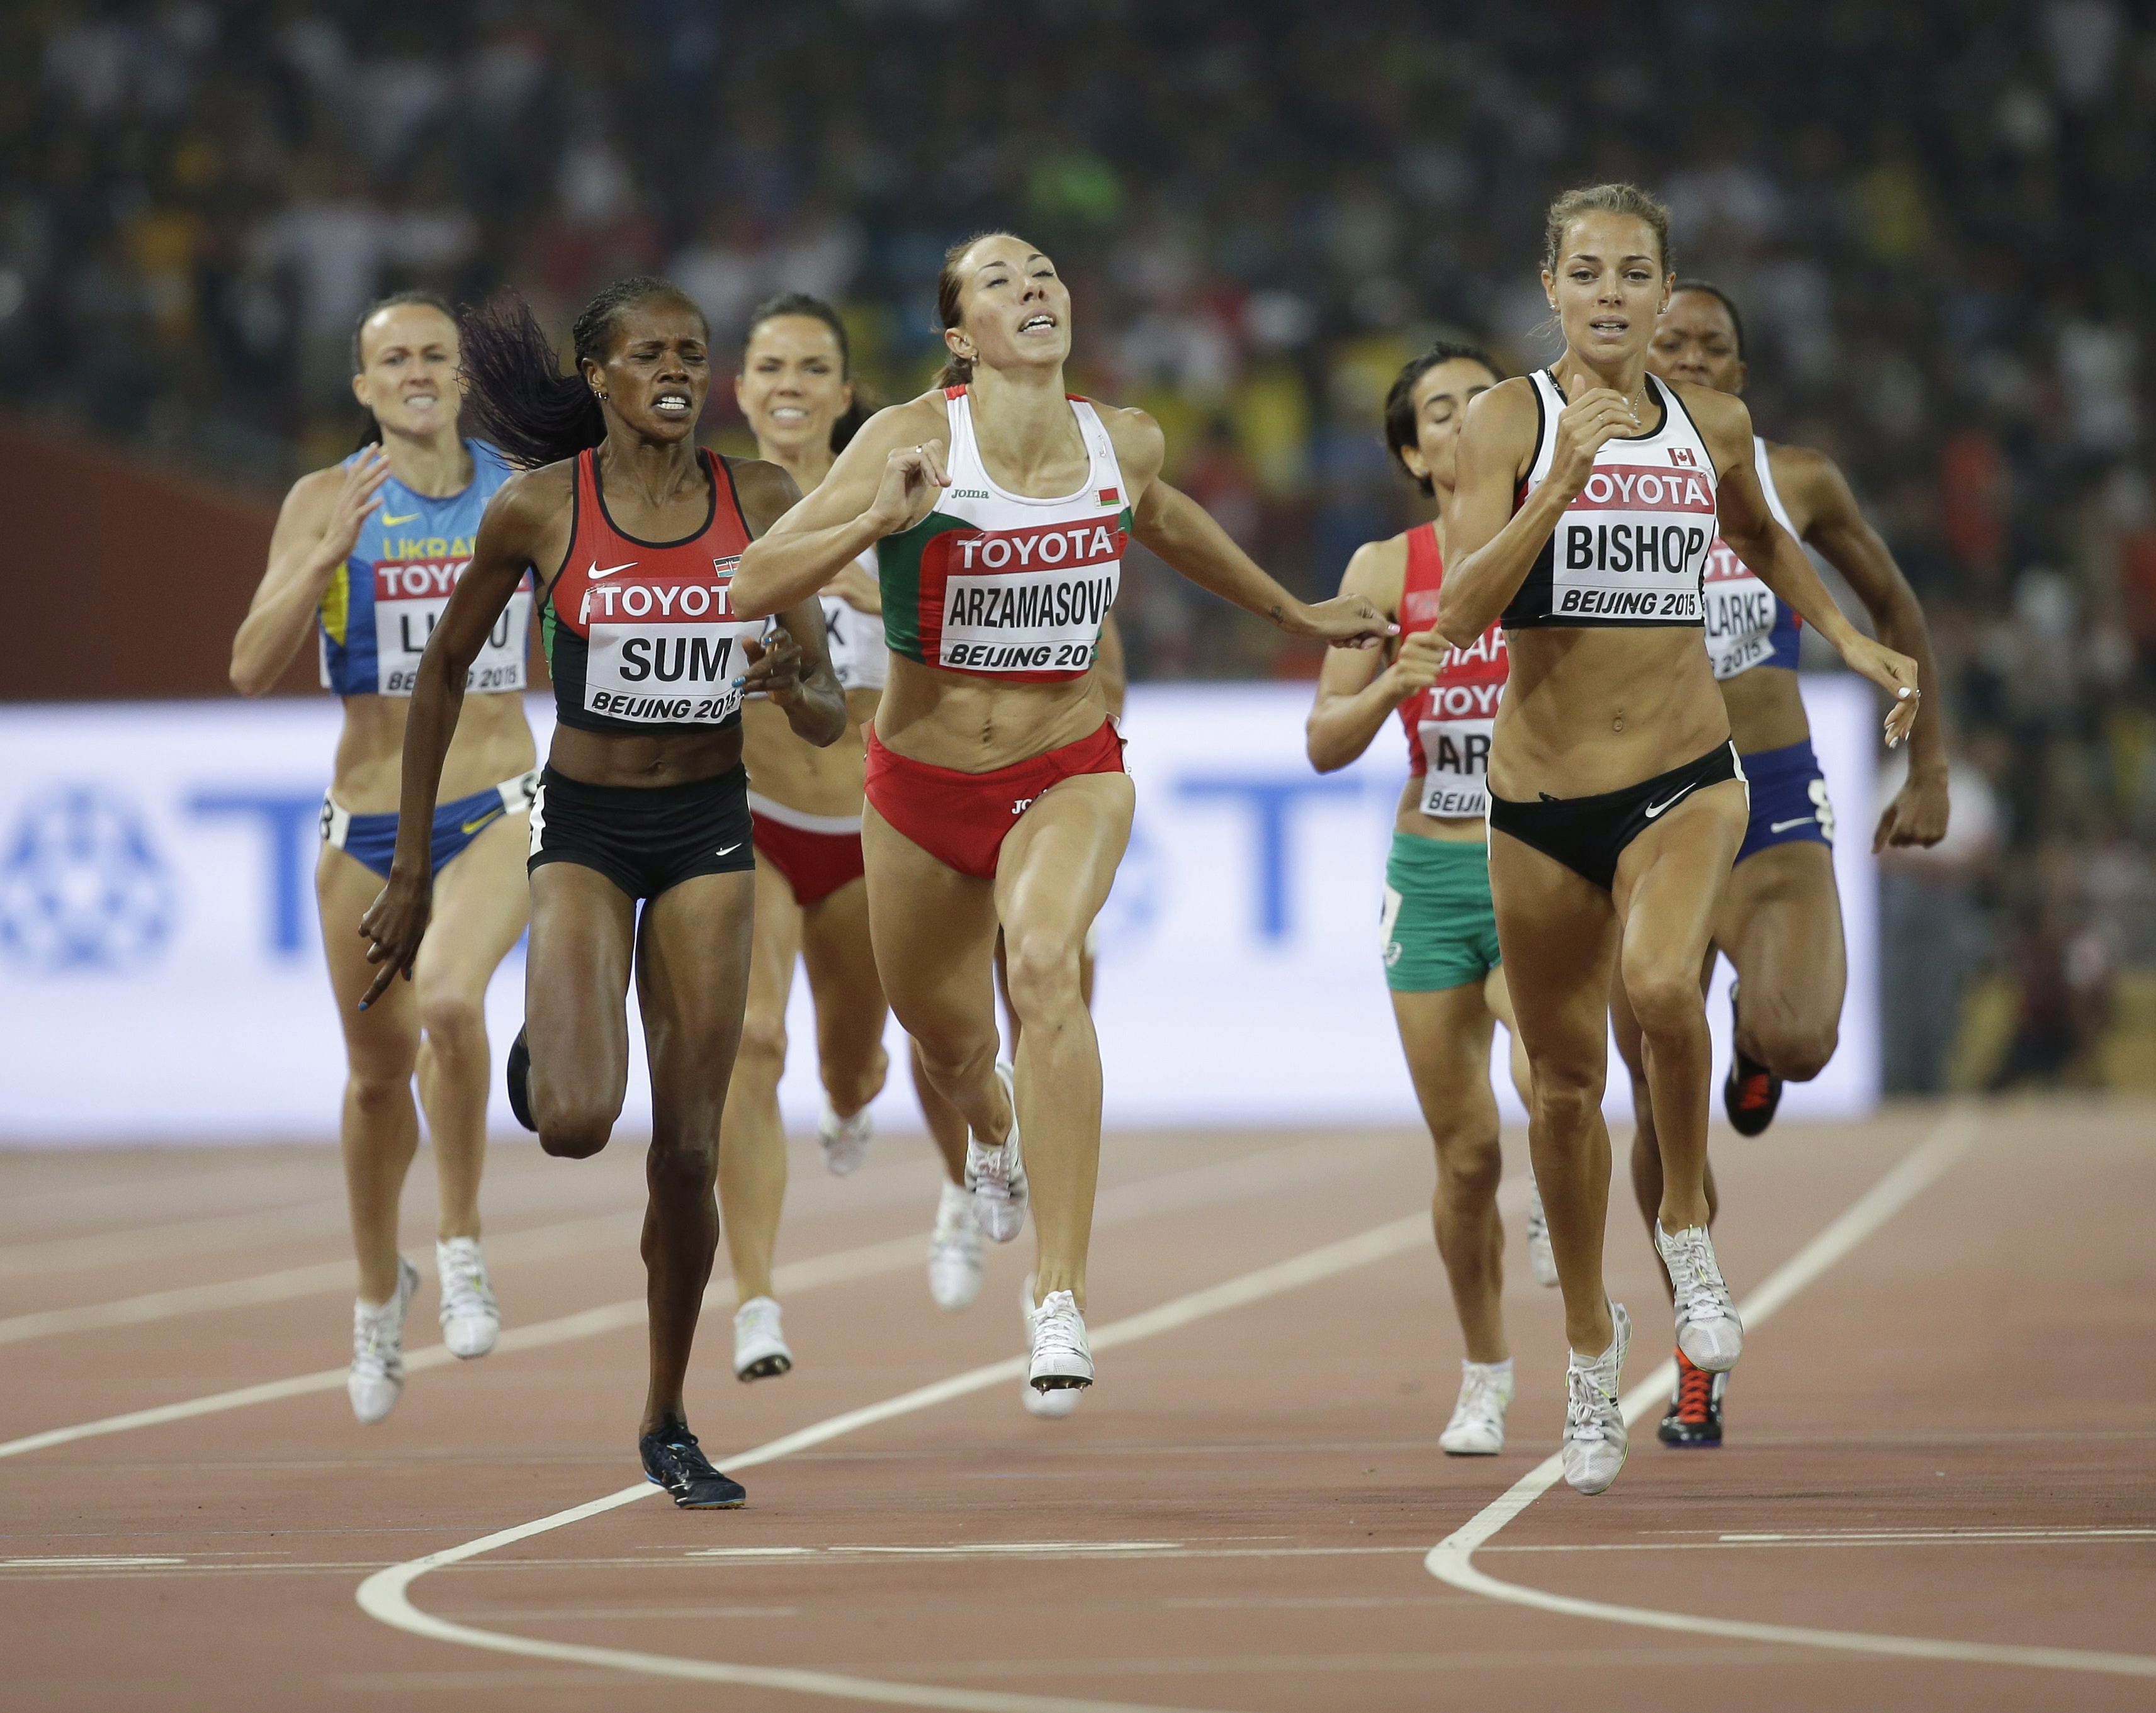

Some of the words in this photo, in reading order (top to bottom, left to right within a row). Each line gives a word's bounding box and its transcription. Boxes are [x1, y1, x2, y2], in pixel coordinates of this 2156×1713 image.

[1571, 473, 1710, 506] OYOTA
[957, 526, 1114, 568] TOYOTA
[1566, 524, 1705, 573] BISHOP
[597, 585, 735, 616] TOYOT
[1561, 590, 1657, 615] BEIJING
[1660, 593, 1695, 616] 2015
[1705, 592, 1767, 637] LARKE
[619, 637, 733, 682] SUM
[947, 644, 1052, 667] BEIJING
[1055, 644, 1094, 666] 20
[591, 692, 692, 719] BEIJING
